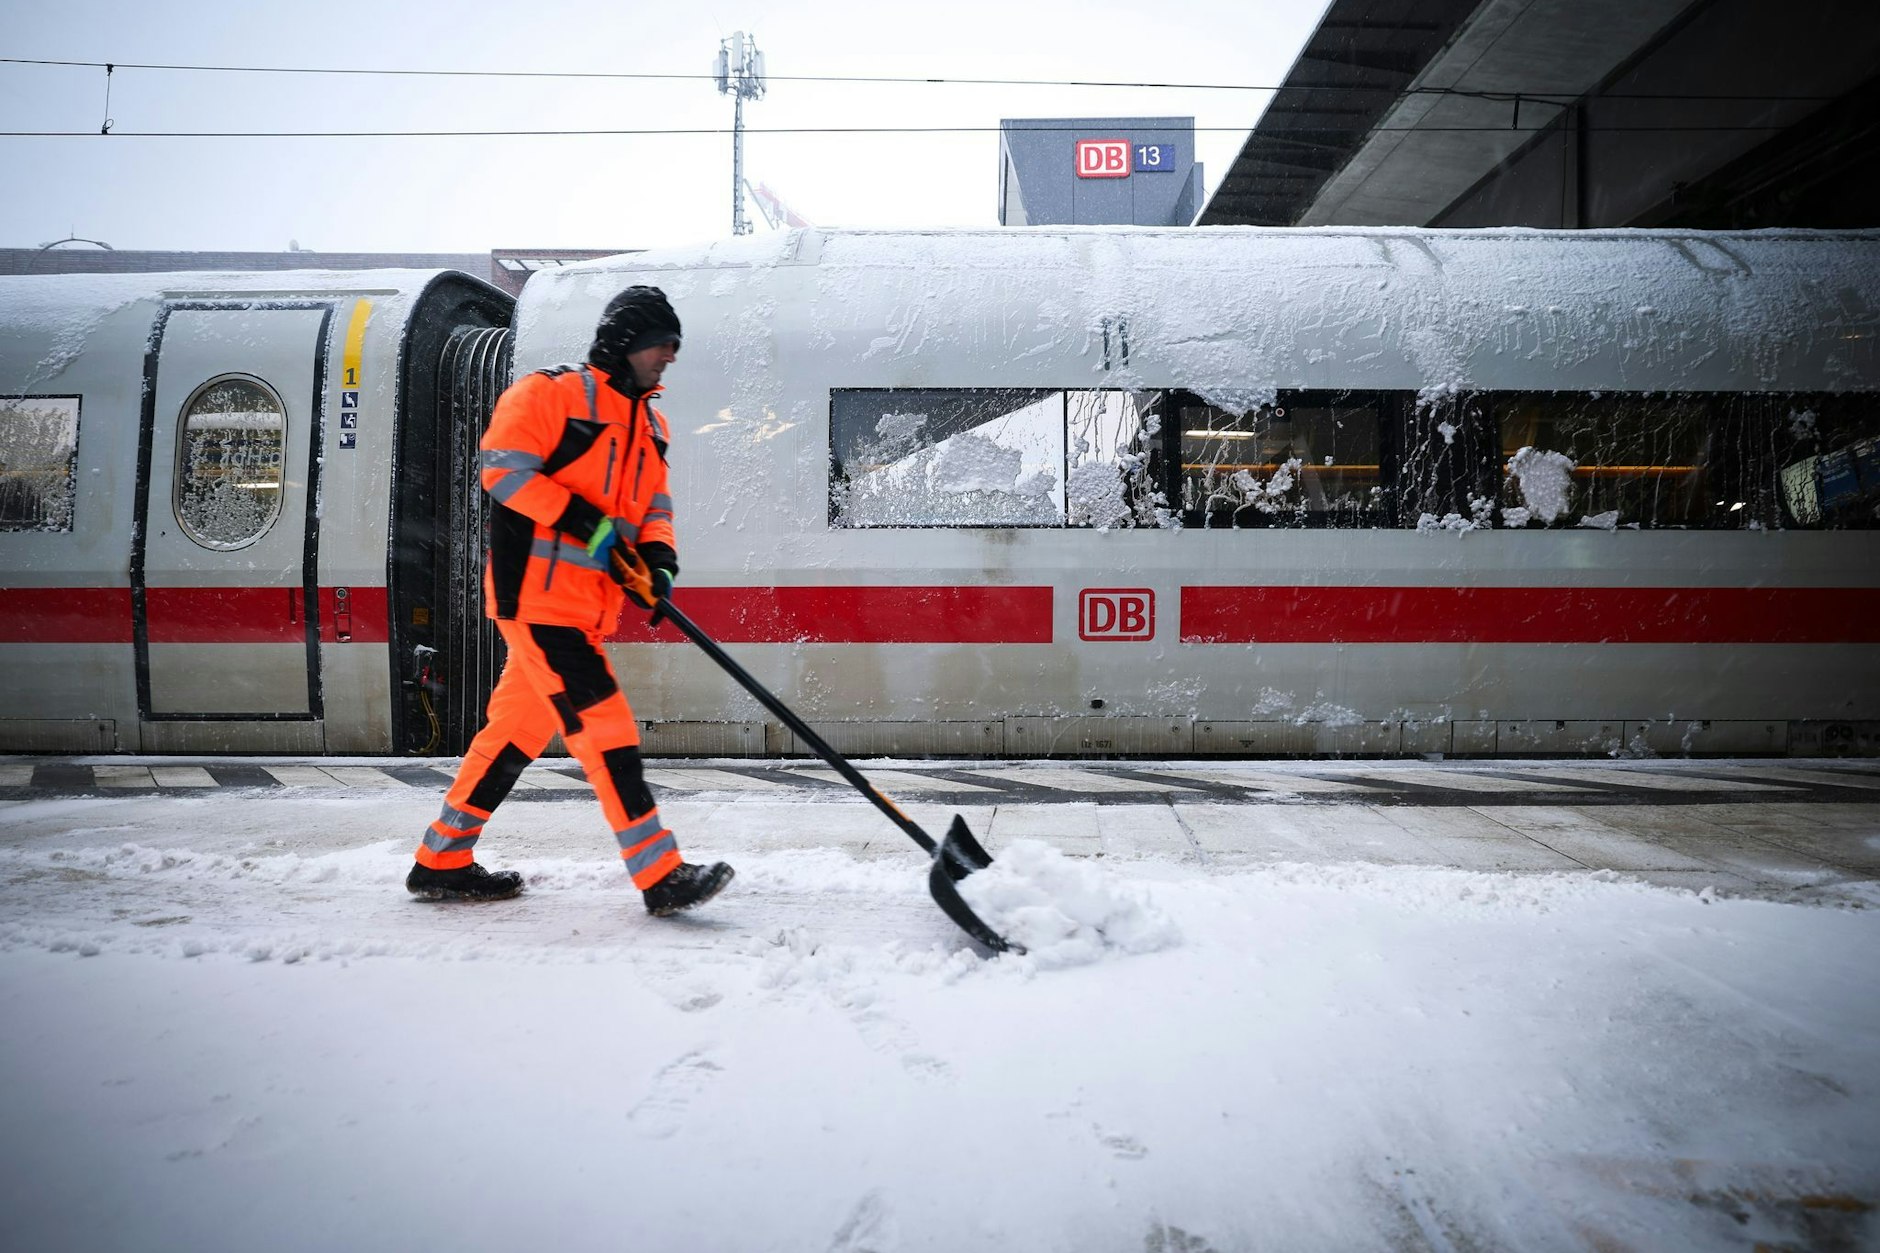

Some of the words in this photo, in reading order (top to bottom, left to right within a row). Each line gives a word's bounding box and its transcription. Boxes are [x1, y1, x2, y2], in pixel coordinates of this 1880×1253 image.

[1084, 146, 1124, 171] DB
[1138, 146, 1161, 166] 13
[345, 367, 357, 385] 1
[1088, 597, 1146, 633] DB
